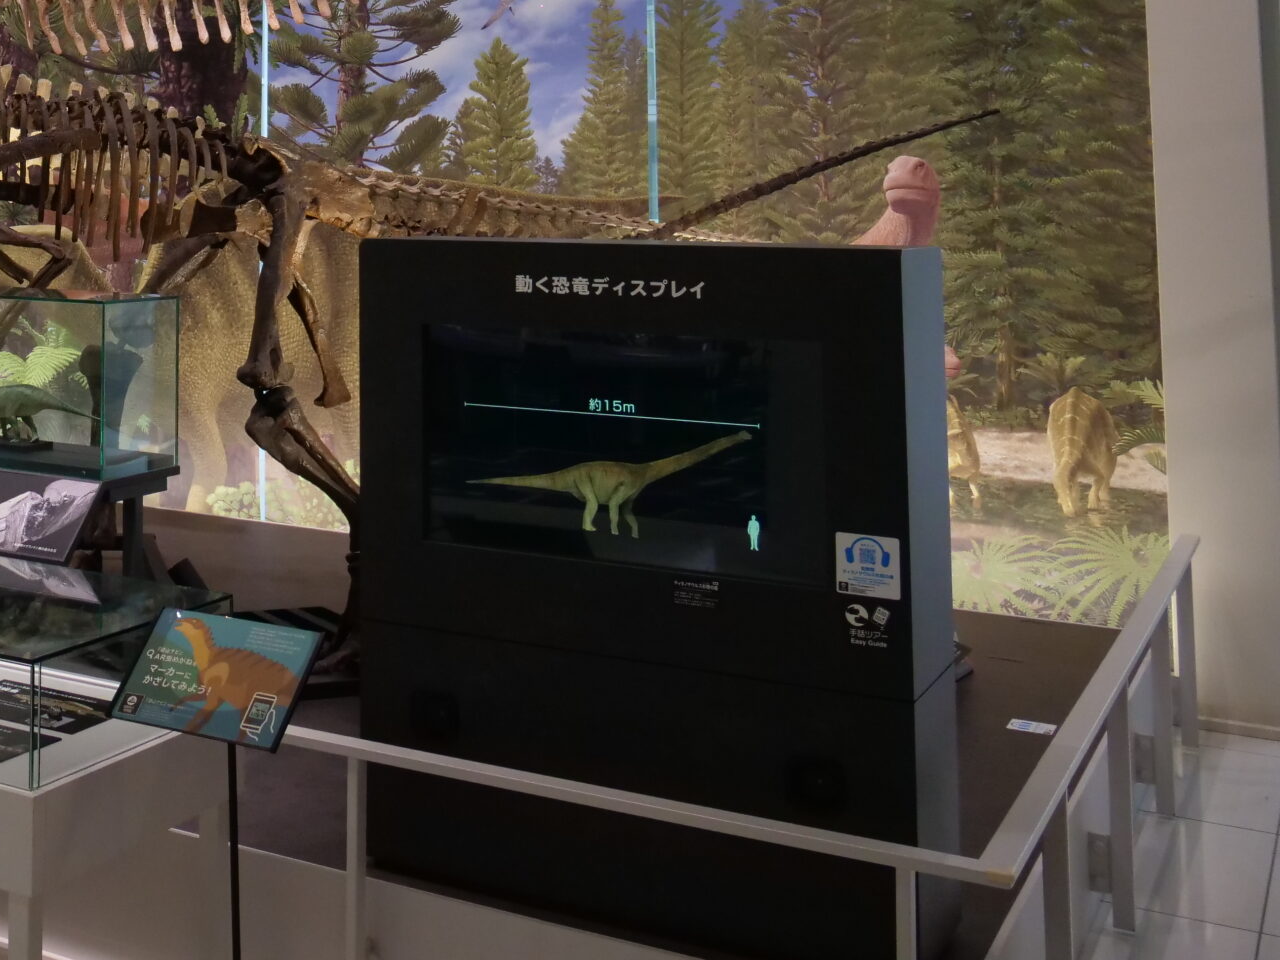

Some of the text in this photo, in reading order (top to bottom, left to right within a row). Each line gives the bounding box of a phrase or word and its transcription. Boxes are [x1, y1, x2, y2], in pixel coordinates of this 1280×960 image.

[515, 275, 705, 299] 動く恐竜ディスプレイ
[588, 398, 635, 413] 約15m
[849, 628, 889, 639] 手話ツアー
[850, 637, 888, 648] Easy Guide
[150, 664, 192, 680] マーカーに
[142, 675, 212, 696] かざしてみよう！
